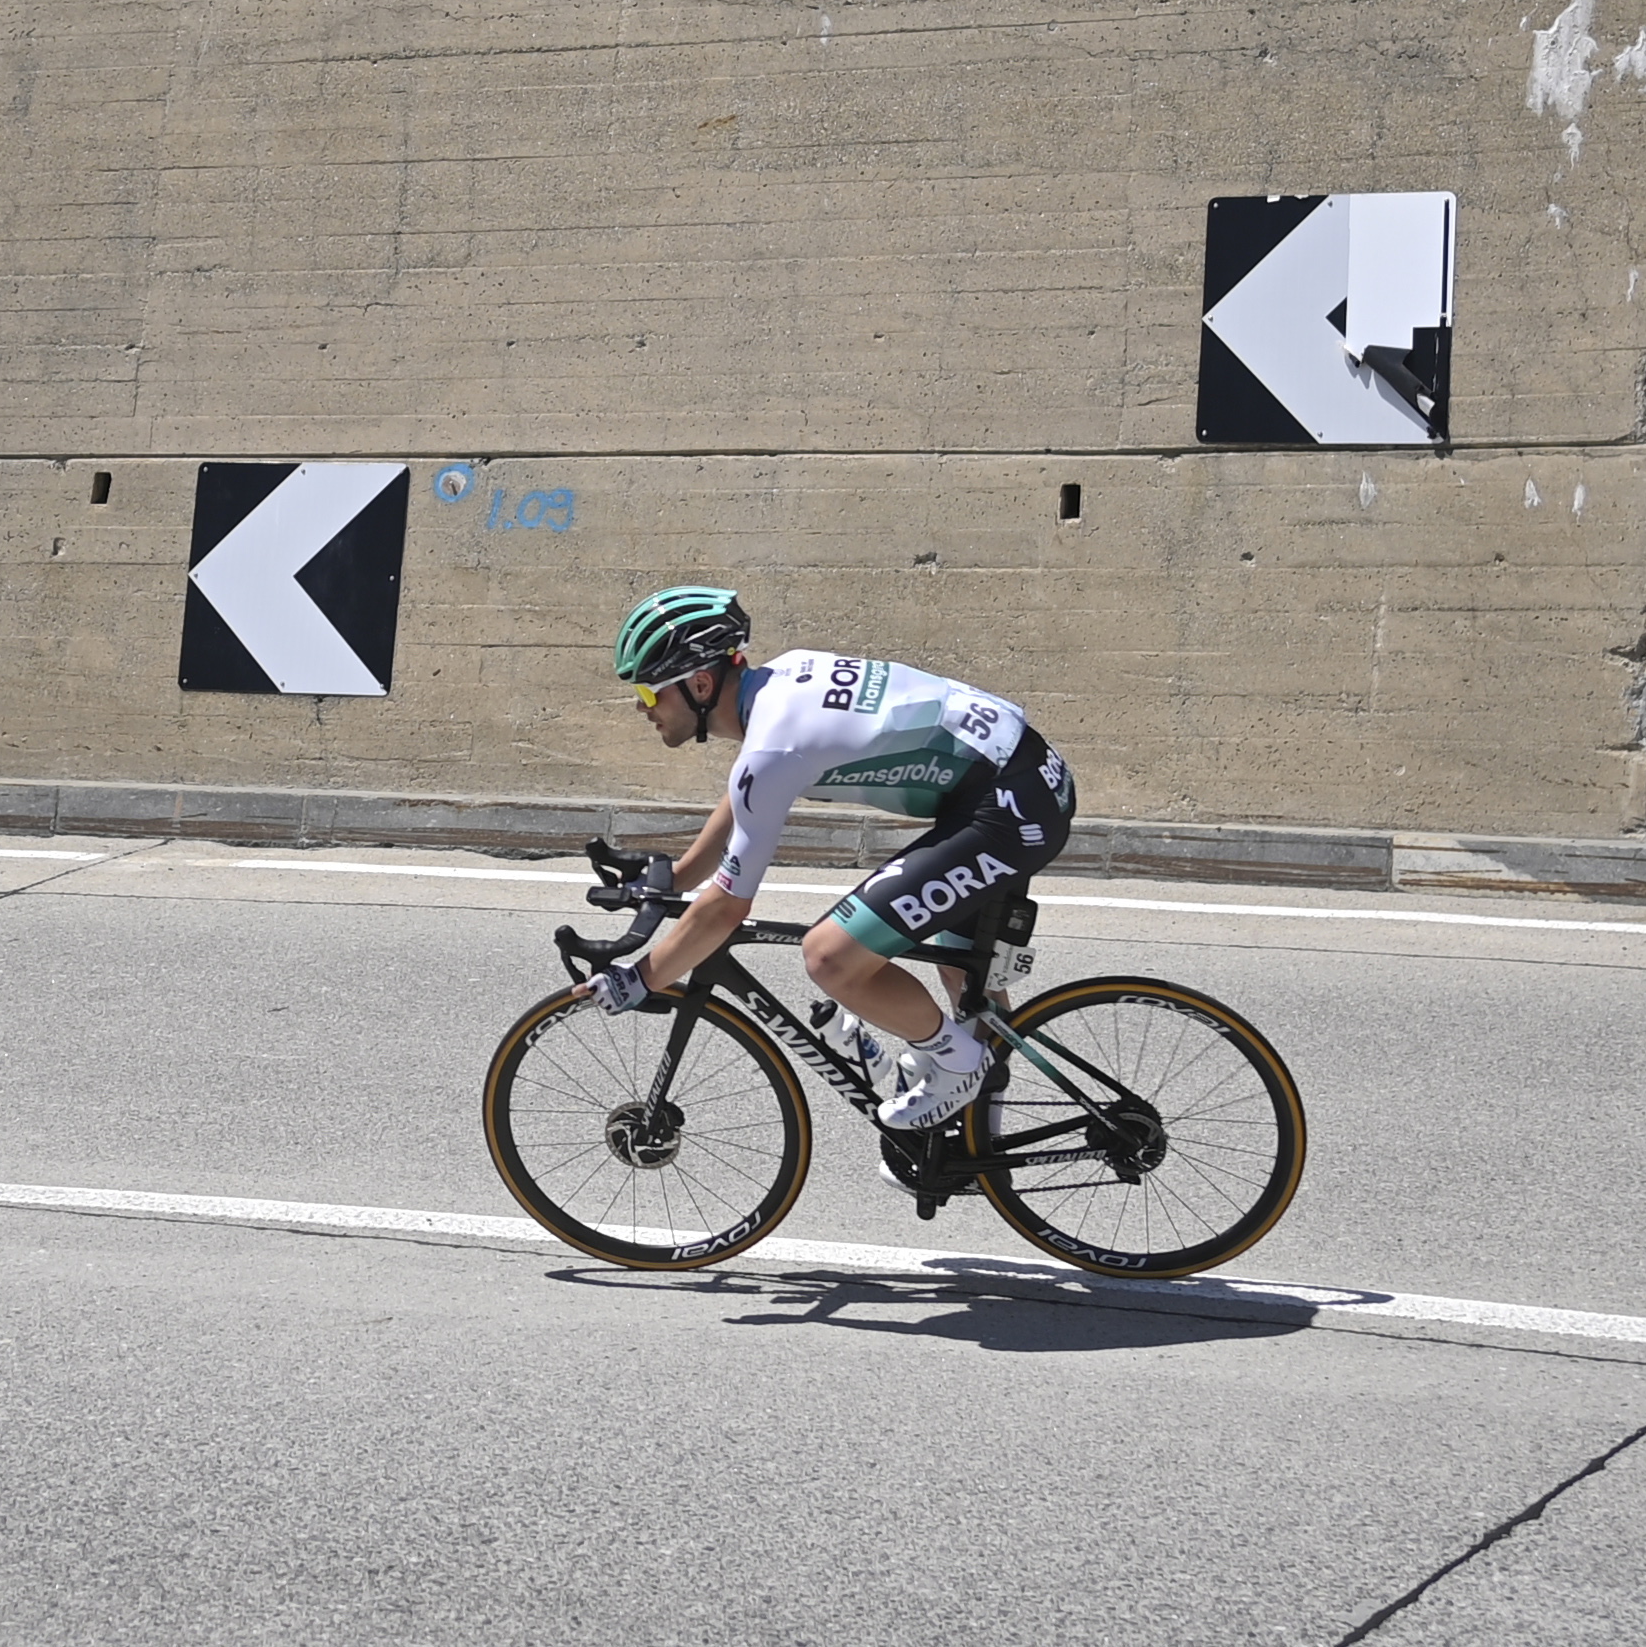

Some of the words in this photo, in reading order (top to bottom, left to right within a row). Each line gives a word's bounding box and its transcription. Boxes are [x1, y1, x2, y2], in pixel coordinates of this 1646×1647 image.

[959, 702, 1000, 741] 56
[825, 755, 954, 787] hansgrohe
[889, 852, 1019, 931] BORA
[1014, 953, 1034, 975] 56
[1117, 994, 1232, 1035] roval
[745, 990, 881, 1123] S-WORKS
[671, 1210, 762, 1260] roval
[1036, 1228, 1148, 1268] roval
